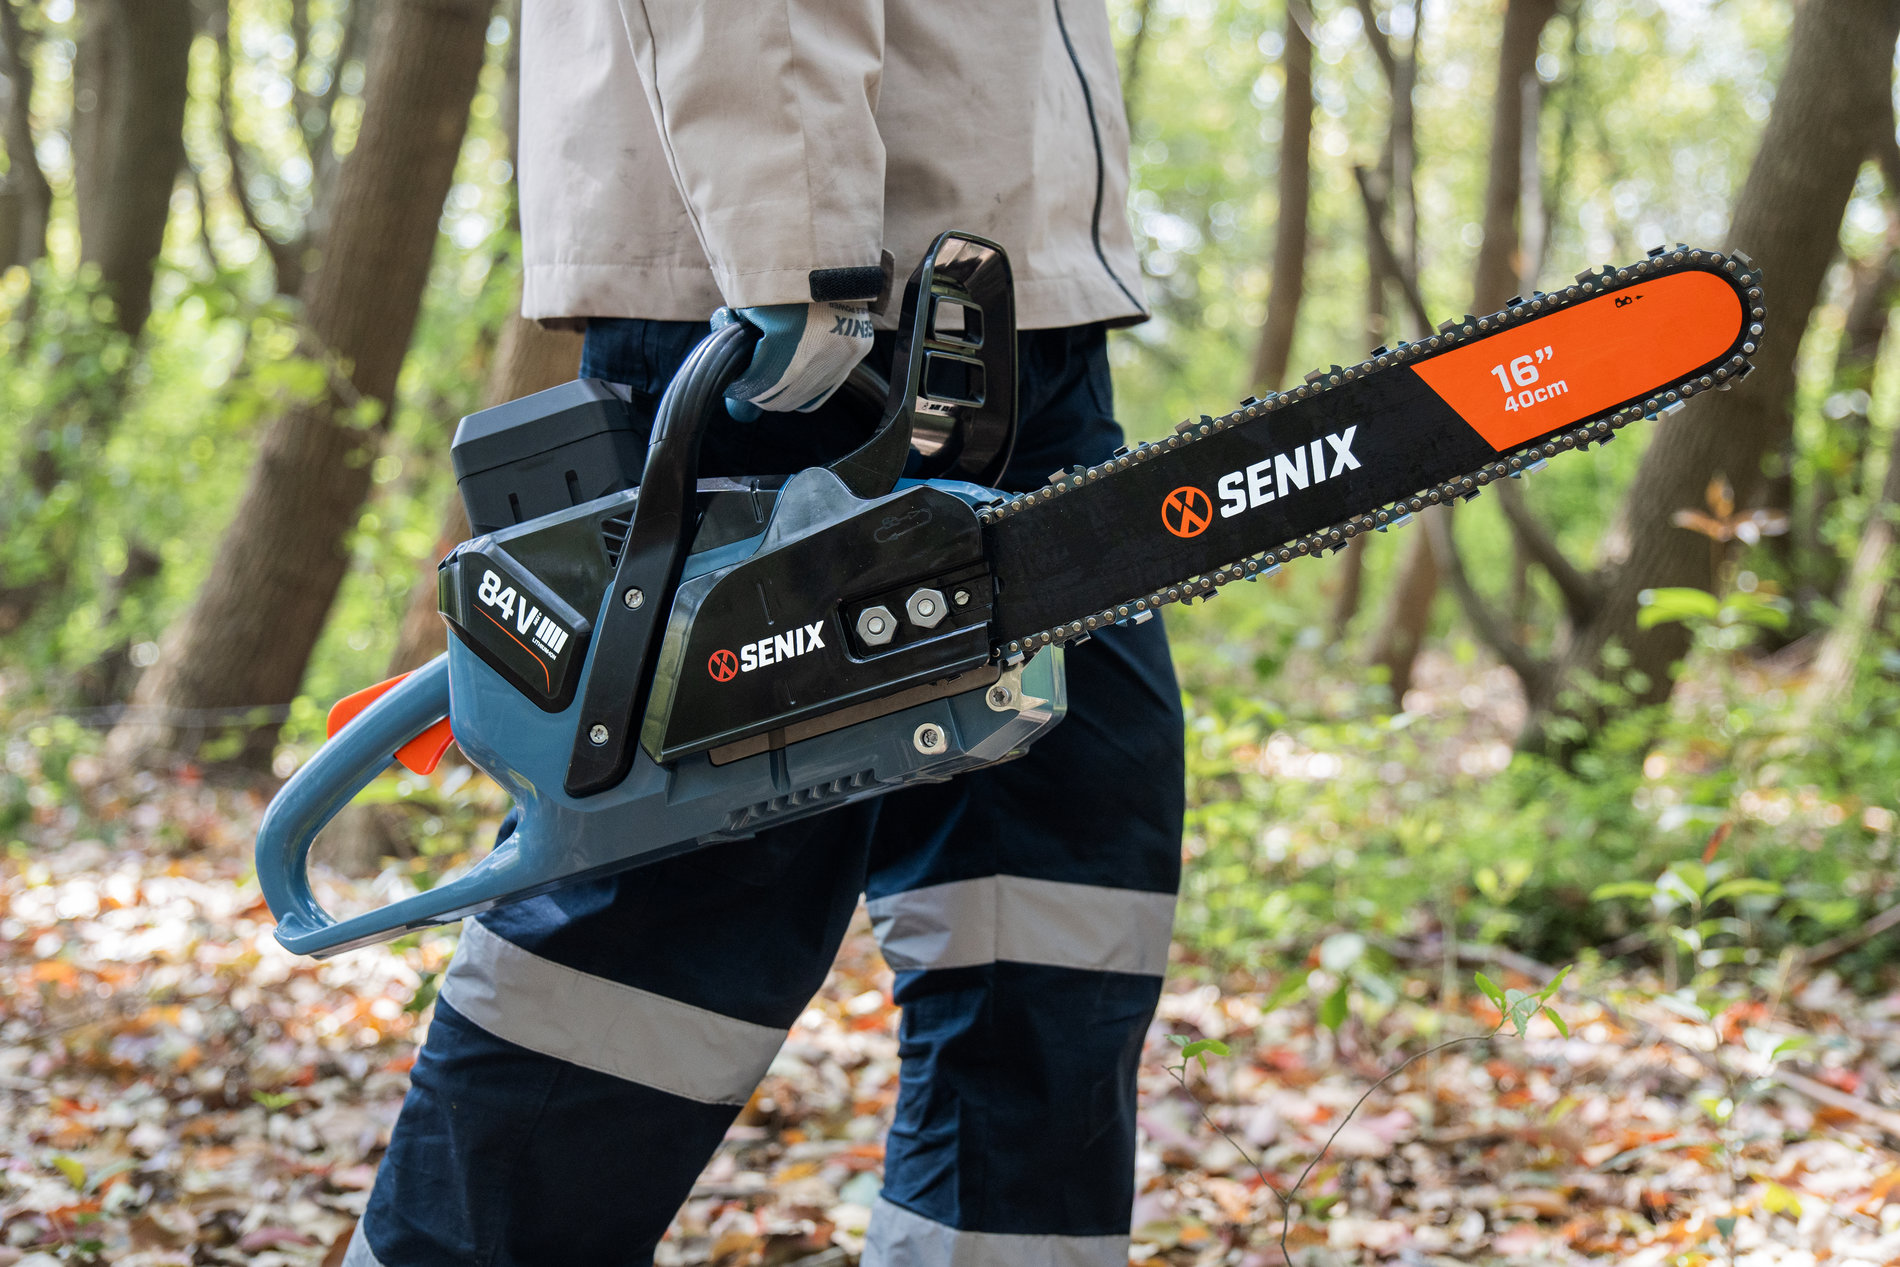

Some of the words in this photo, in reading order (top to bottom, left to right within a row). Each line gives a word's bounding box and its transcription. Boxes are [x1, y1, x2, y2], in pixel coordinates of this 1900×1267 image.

[830, 315, 874, 338] SENIX
[1504, 379, 1569, 412] 40cm
[1217, 424, 1362, 519] SENIX
[478, 569, 539, 635] 84V
[740, 620, 826, 673] SENIX
